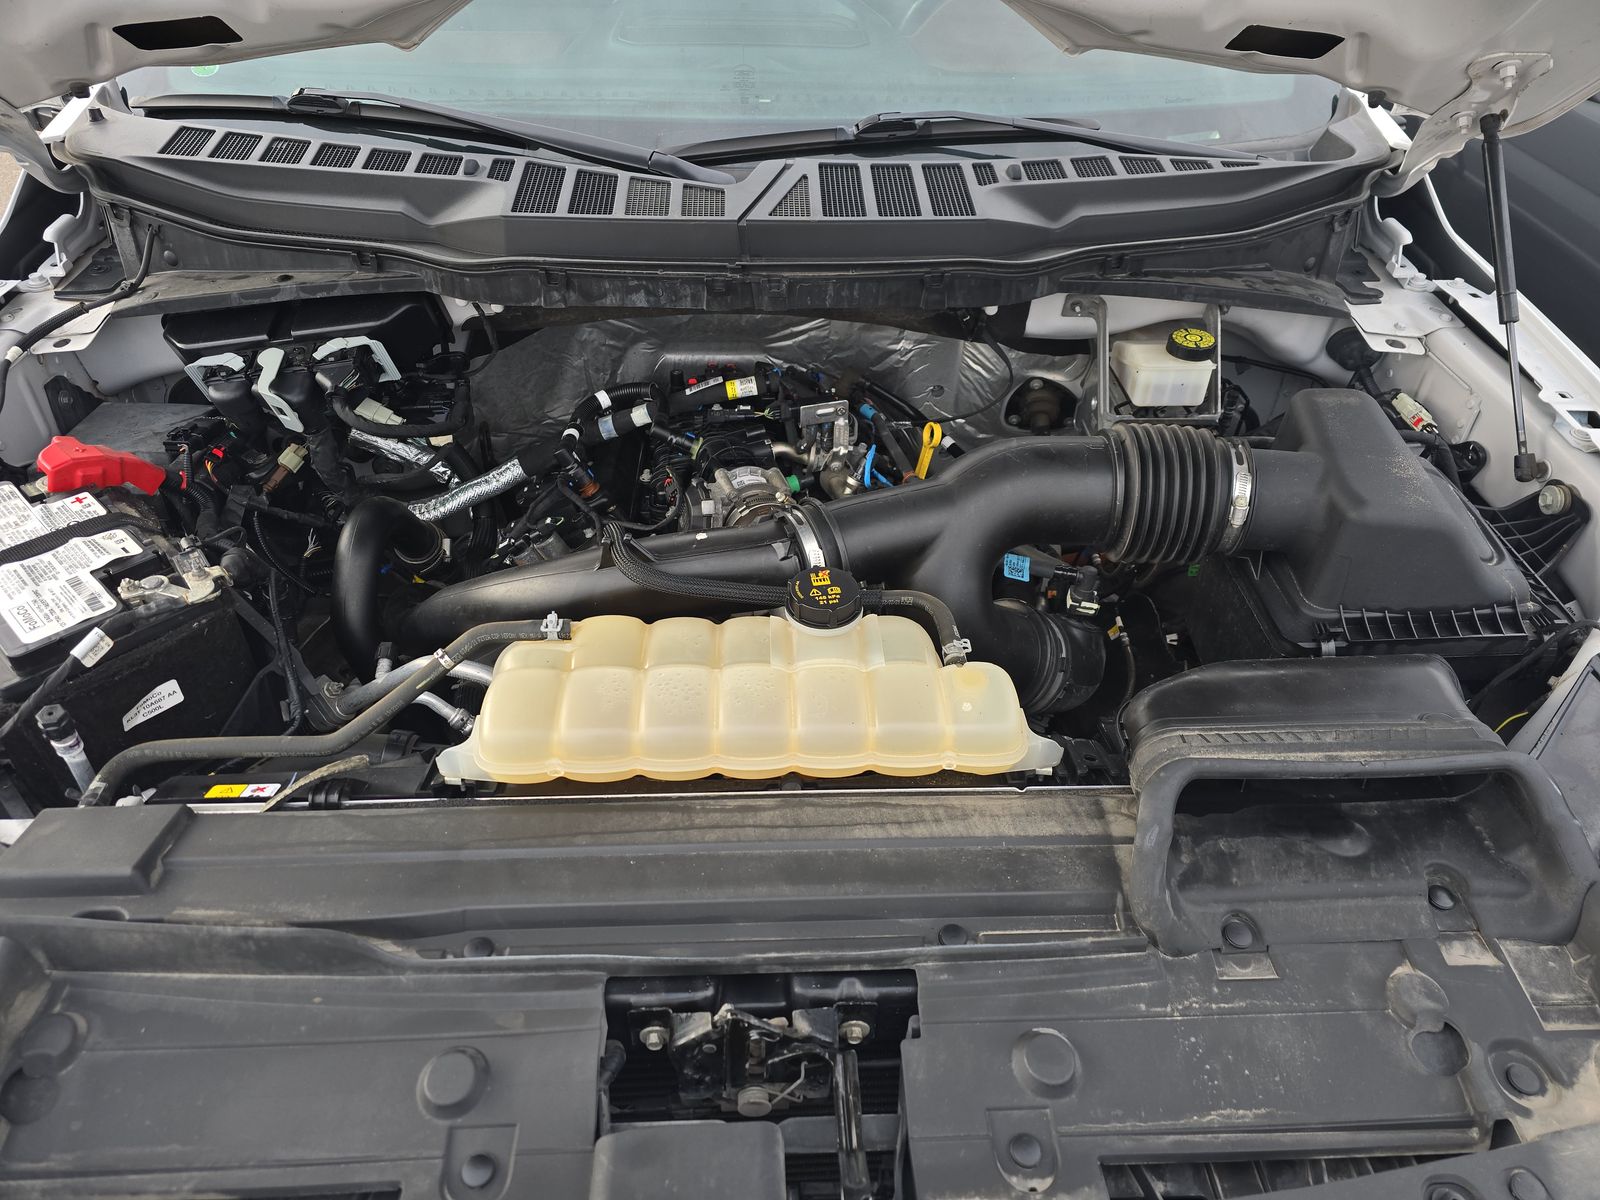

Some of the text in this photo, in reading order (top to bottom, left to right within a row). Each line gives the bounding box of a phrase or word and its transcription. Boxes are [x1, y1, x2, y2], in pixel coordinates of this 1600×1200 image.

[16, 605, 40, 631] FoMoCo
[136, 691, 162, 710] FoMoCo
[167, 690, 177, 698] AA
